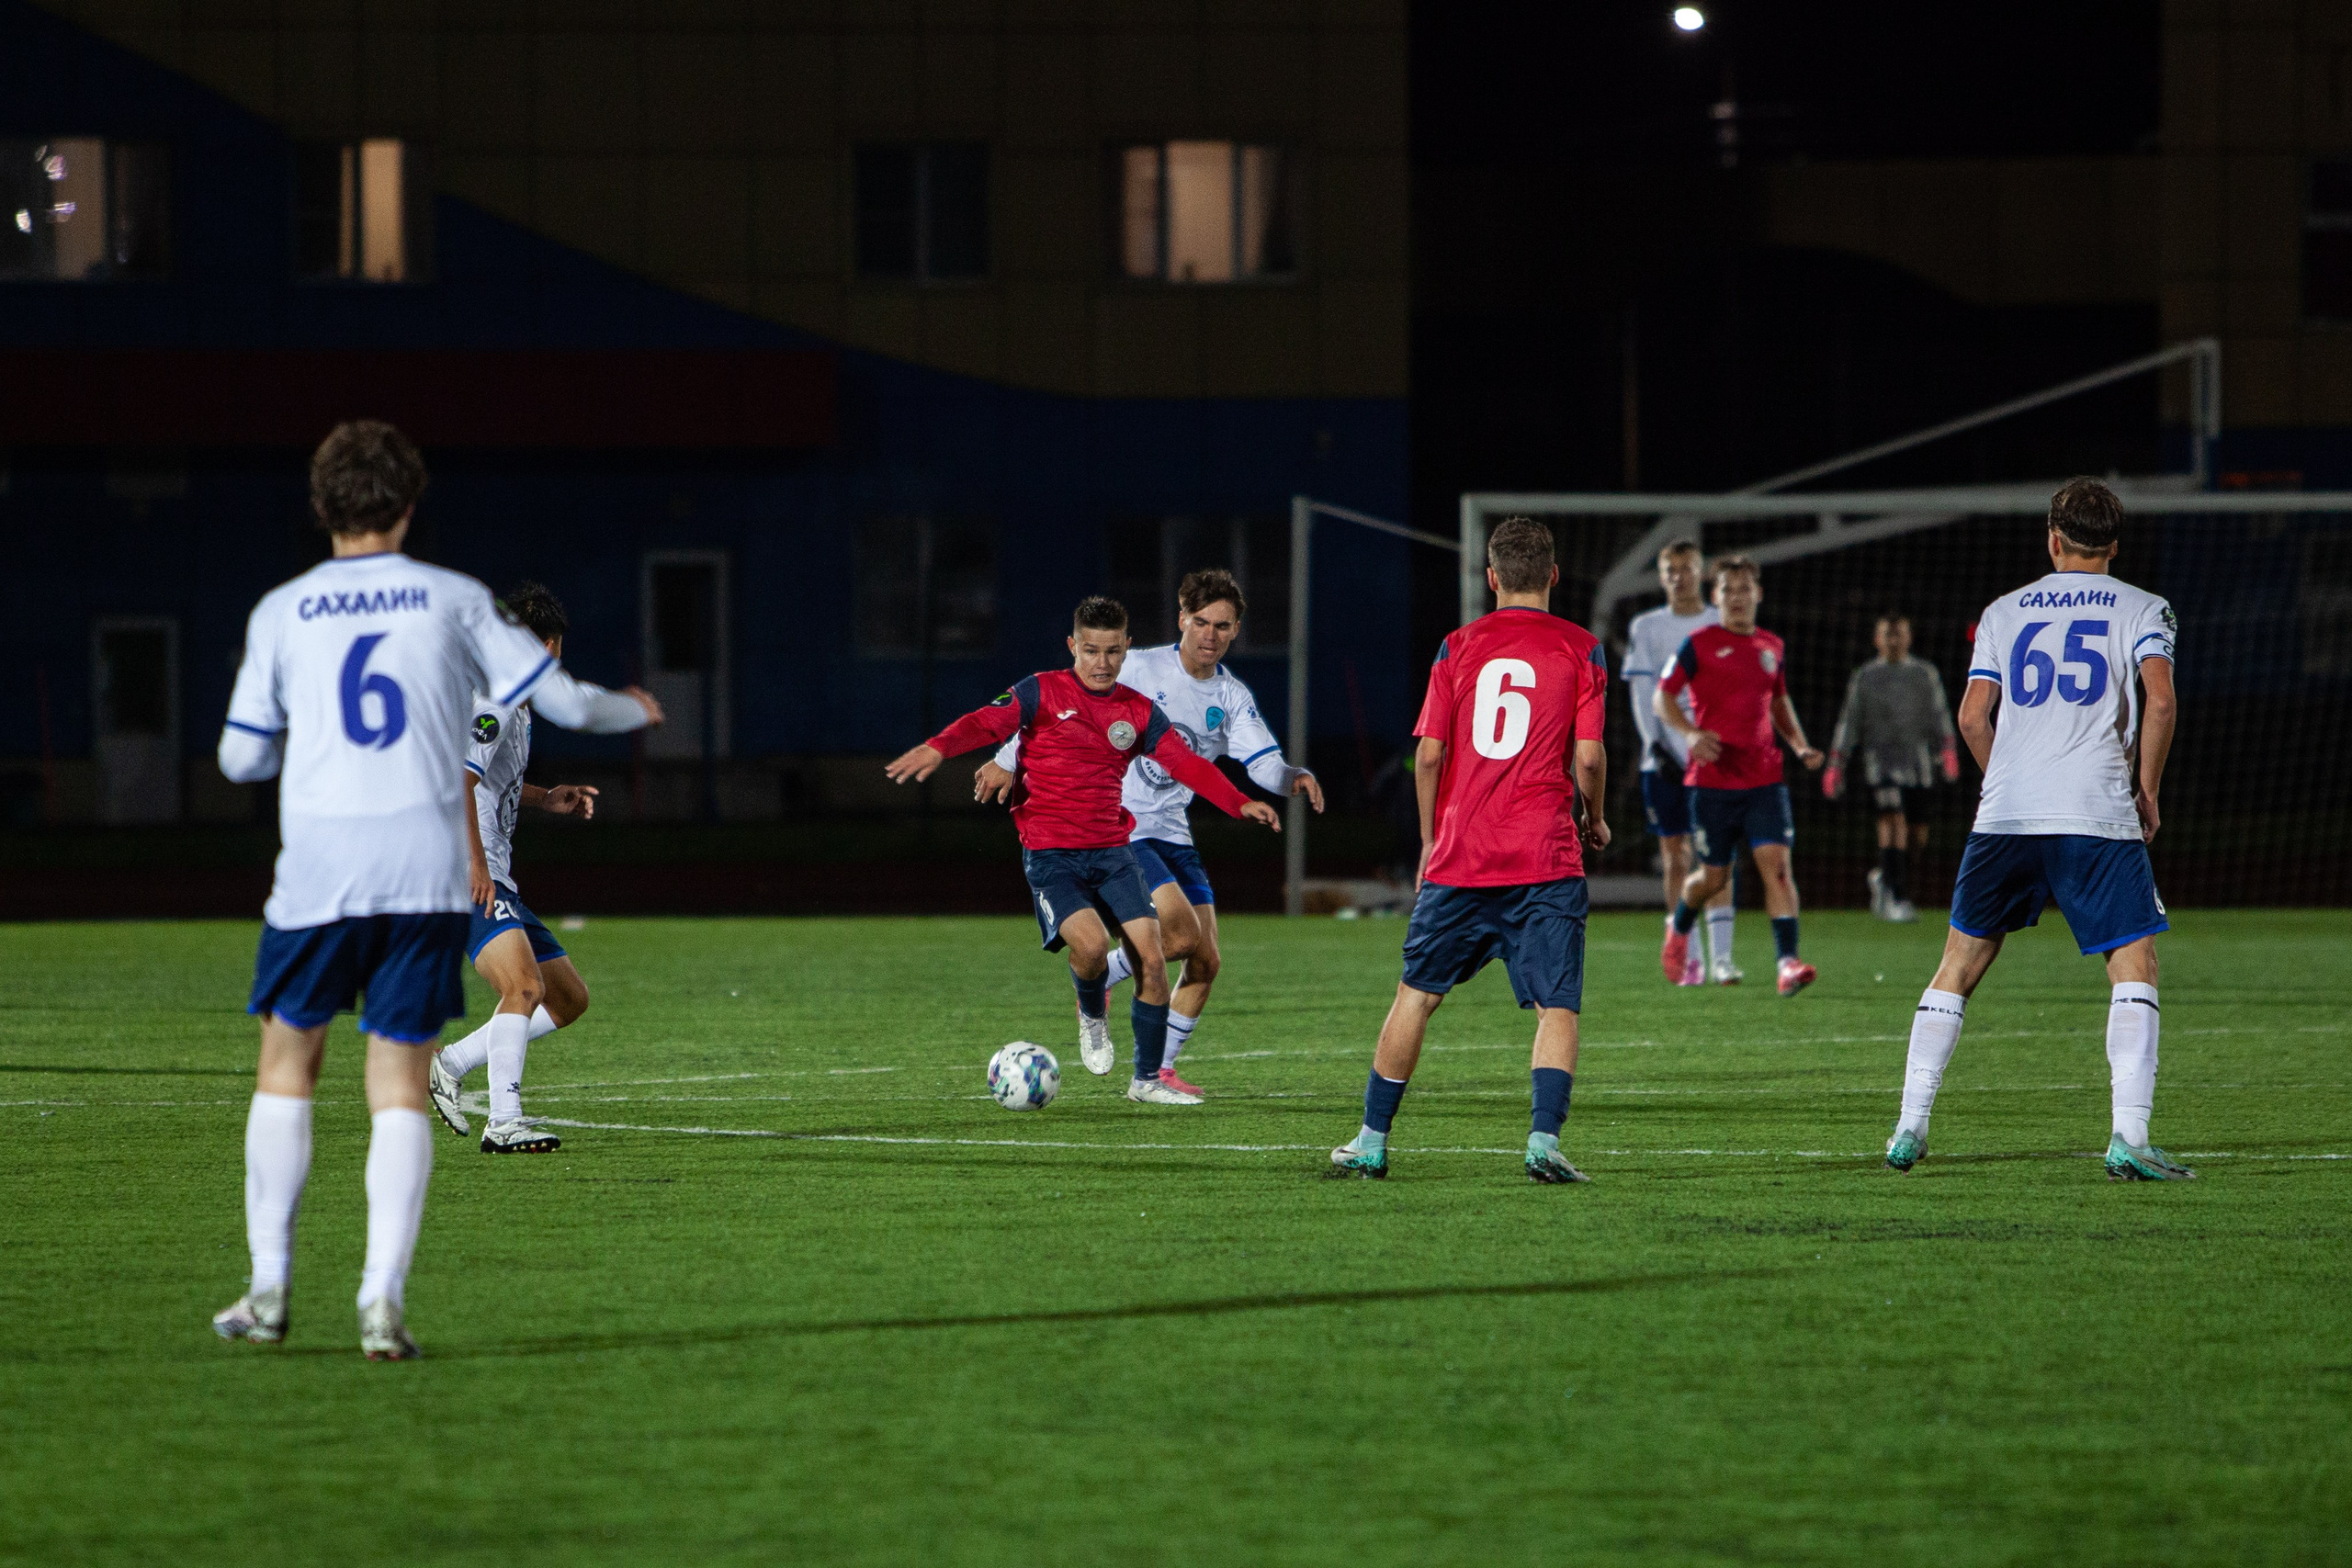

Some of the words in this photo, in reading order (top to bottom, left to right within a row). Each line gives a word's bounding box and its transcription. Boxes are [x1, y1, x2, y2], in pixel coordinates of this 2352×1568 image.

[299, 587, 429, 620] САХАЛИН
[2019, 590, 2117, 609] САХАЛИН
[340, 631, 406, 751] 6
[2009, 619, 2109, 708] 65
[1473, 659, 1536, 760] 6
